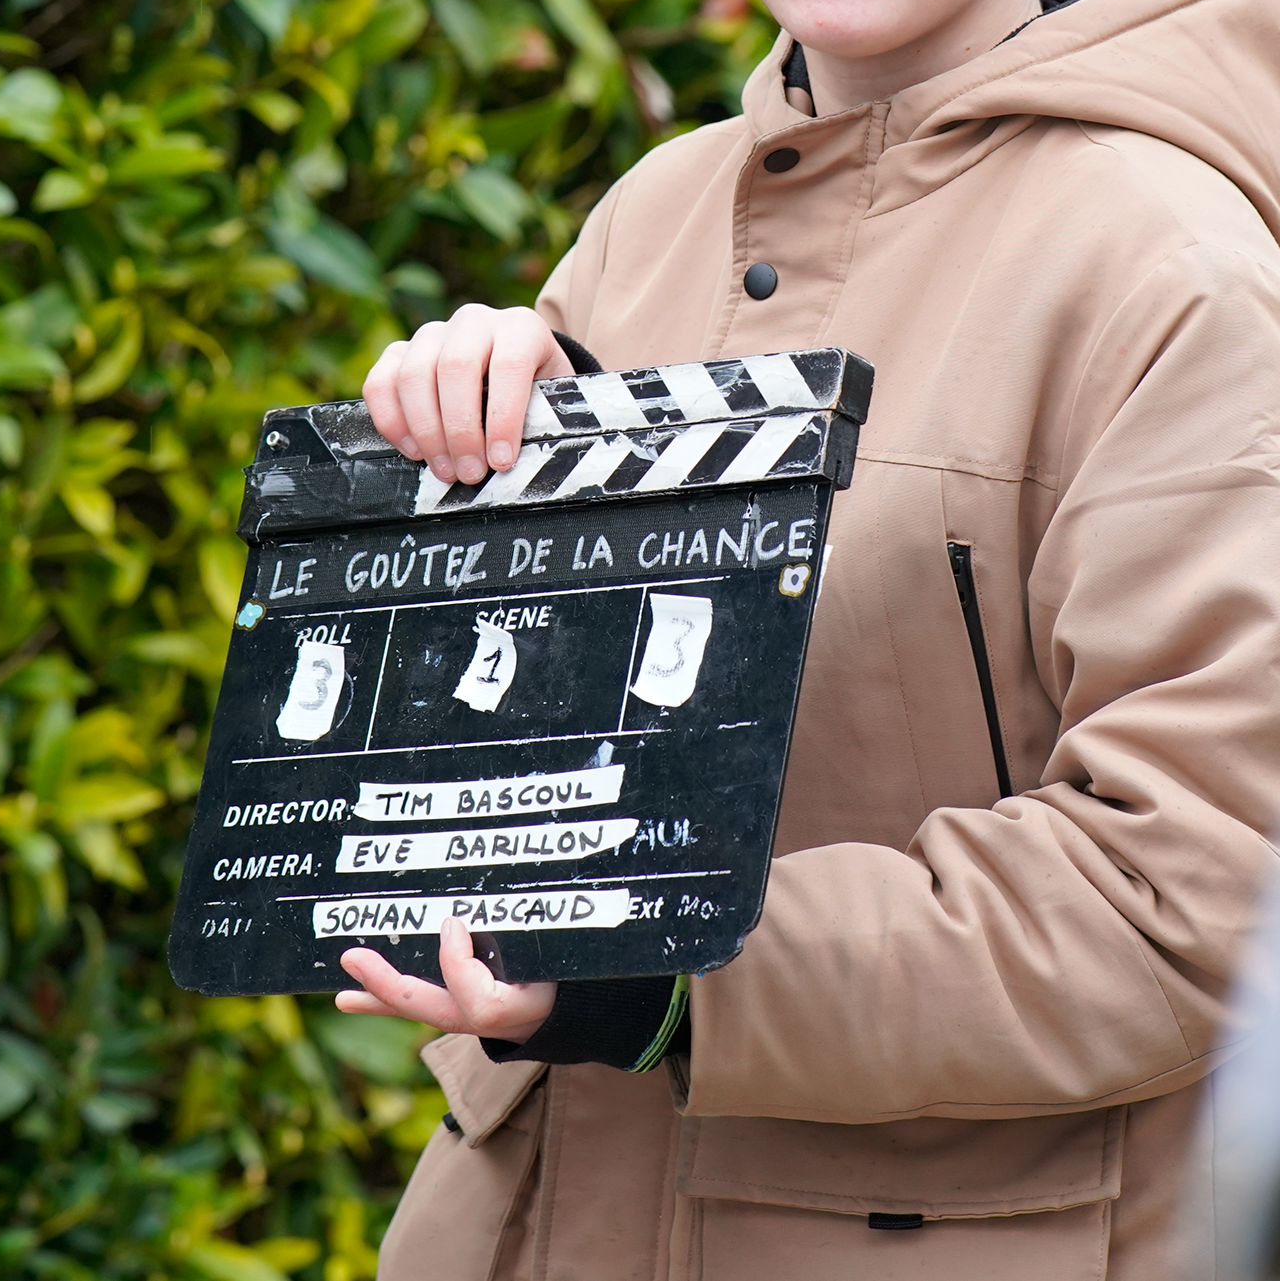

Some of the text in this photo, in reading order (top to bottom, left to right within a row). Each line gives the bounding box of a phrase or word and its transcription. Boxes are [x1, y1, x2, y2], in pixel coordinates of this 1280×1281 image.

[270, 557, 317, 600] LE
[507, 535, 555, 579] DE
[572, 534, 613, 571] LA
[637, 518, 813, 569] CHANCE
[295, 623, 352, 647] ROLL
[644, 616, 695, 678] 3
[475, 646, 502, 685] 1
[298, 658, 332, 711] 3
[223, 798, 355, 827] DIRECTOR:
[375, 781, 593, 816] TIM BASCOUL
[352, 825, 604, 868] EVE BARILLON
[614, 817, 700, 856] AUL
[213, 853, 322, 881] CAMERA:
[321, 903, 428, 933] SOHAN
[628, 896, 665, 920] Ext
